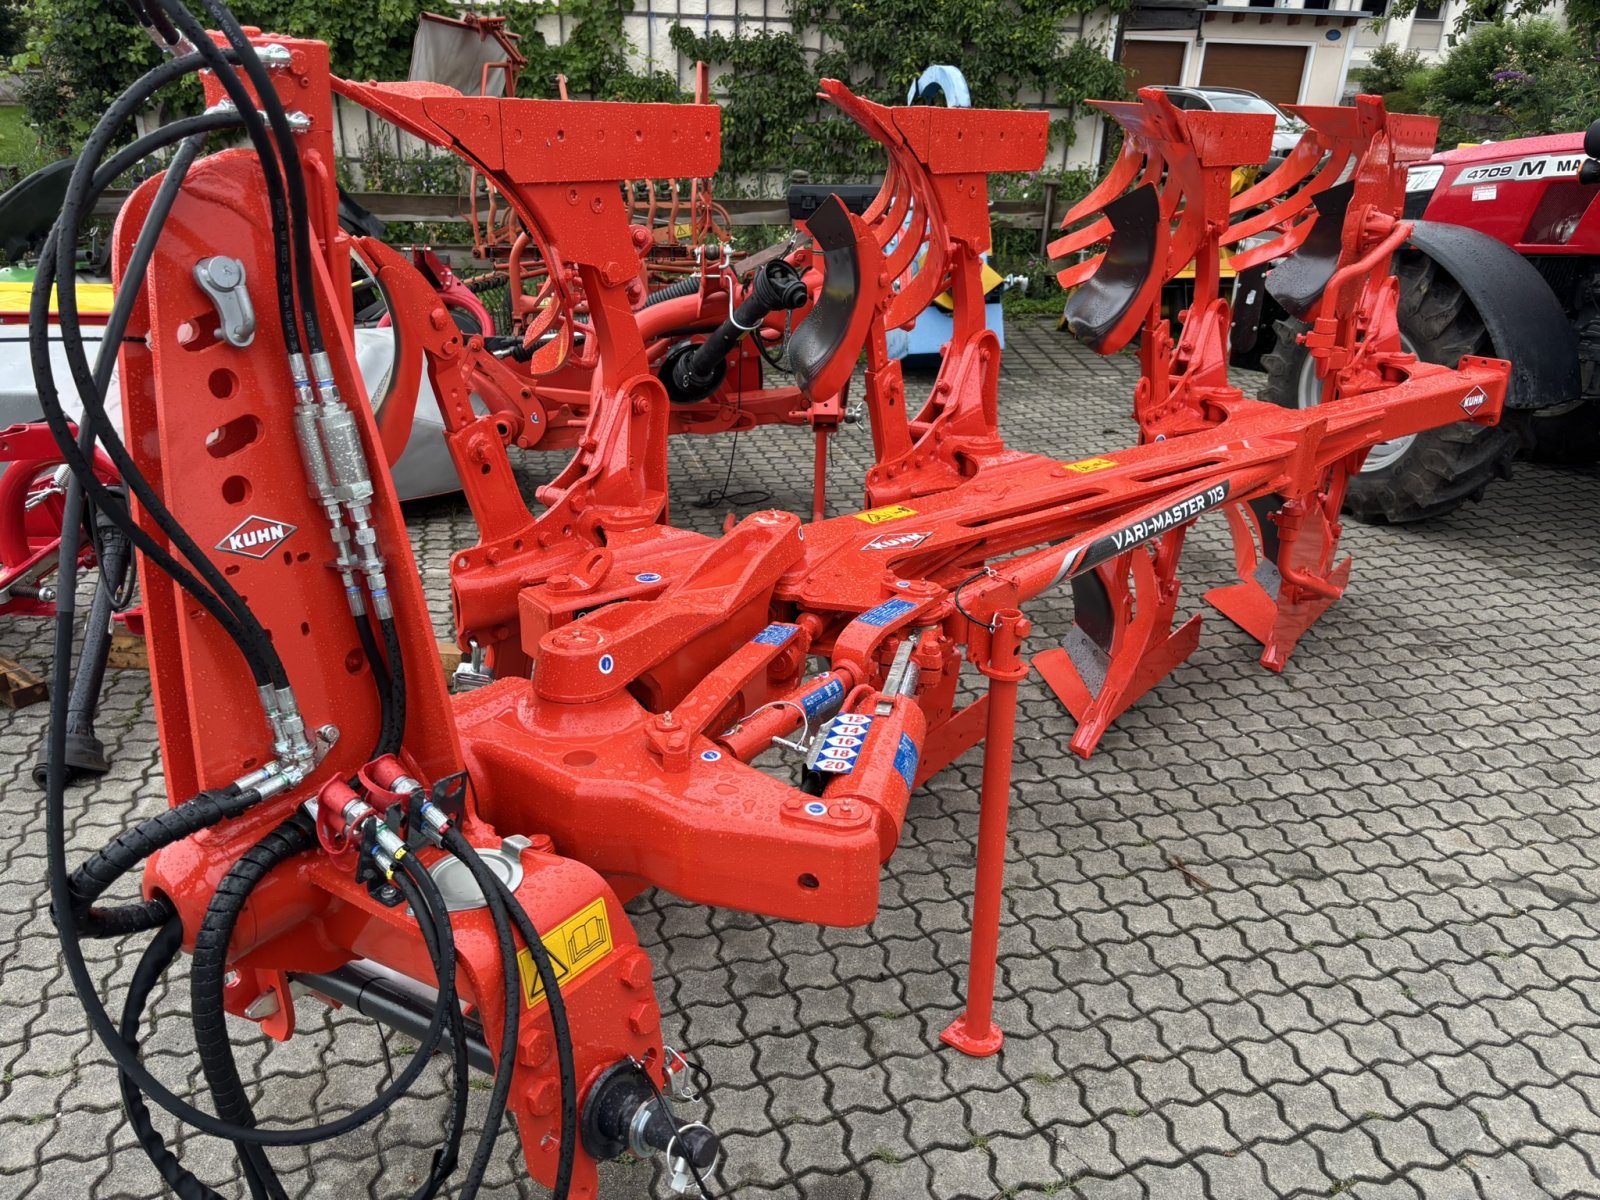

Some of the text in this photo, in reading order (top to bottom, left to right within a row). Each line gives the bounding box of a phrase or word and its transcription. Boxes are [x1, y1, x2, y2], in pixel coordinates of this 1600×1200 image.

[1466, 165, 1513, 180] 4709
[1518, 160, 1547, 177] M
[1463, 394, 1484, 408] KUHN
[1111, 485, 1225, 550] VARI-MASTER 113
[228, 524, 285, 551] KUHN
[870, 532, 923, 549] KUHN
[848, 715, 864, 723] 12
[842, 726, 859, 734] 14
[836, 737, 855, 746] 16
[832, 749, 850, 757] 18
[824, 760, 845, 770] 20
